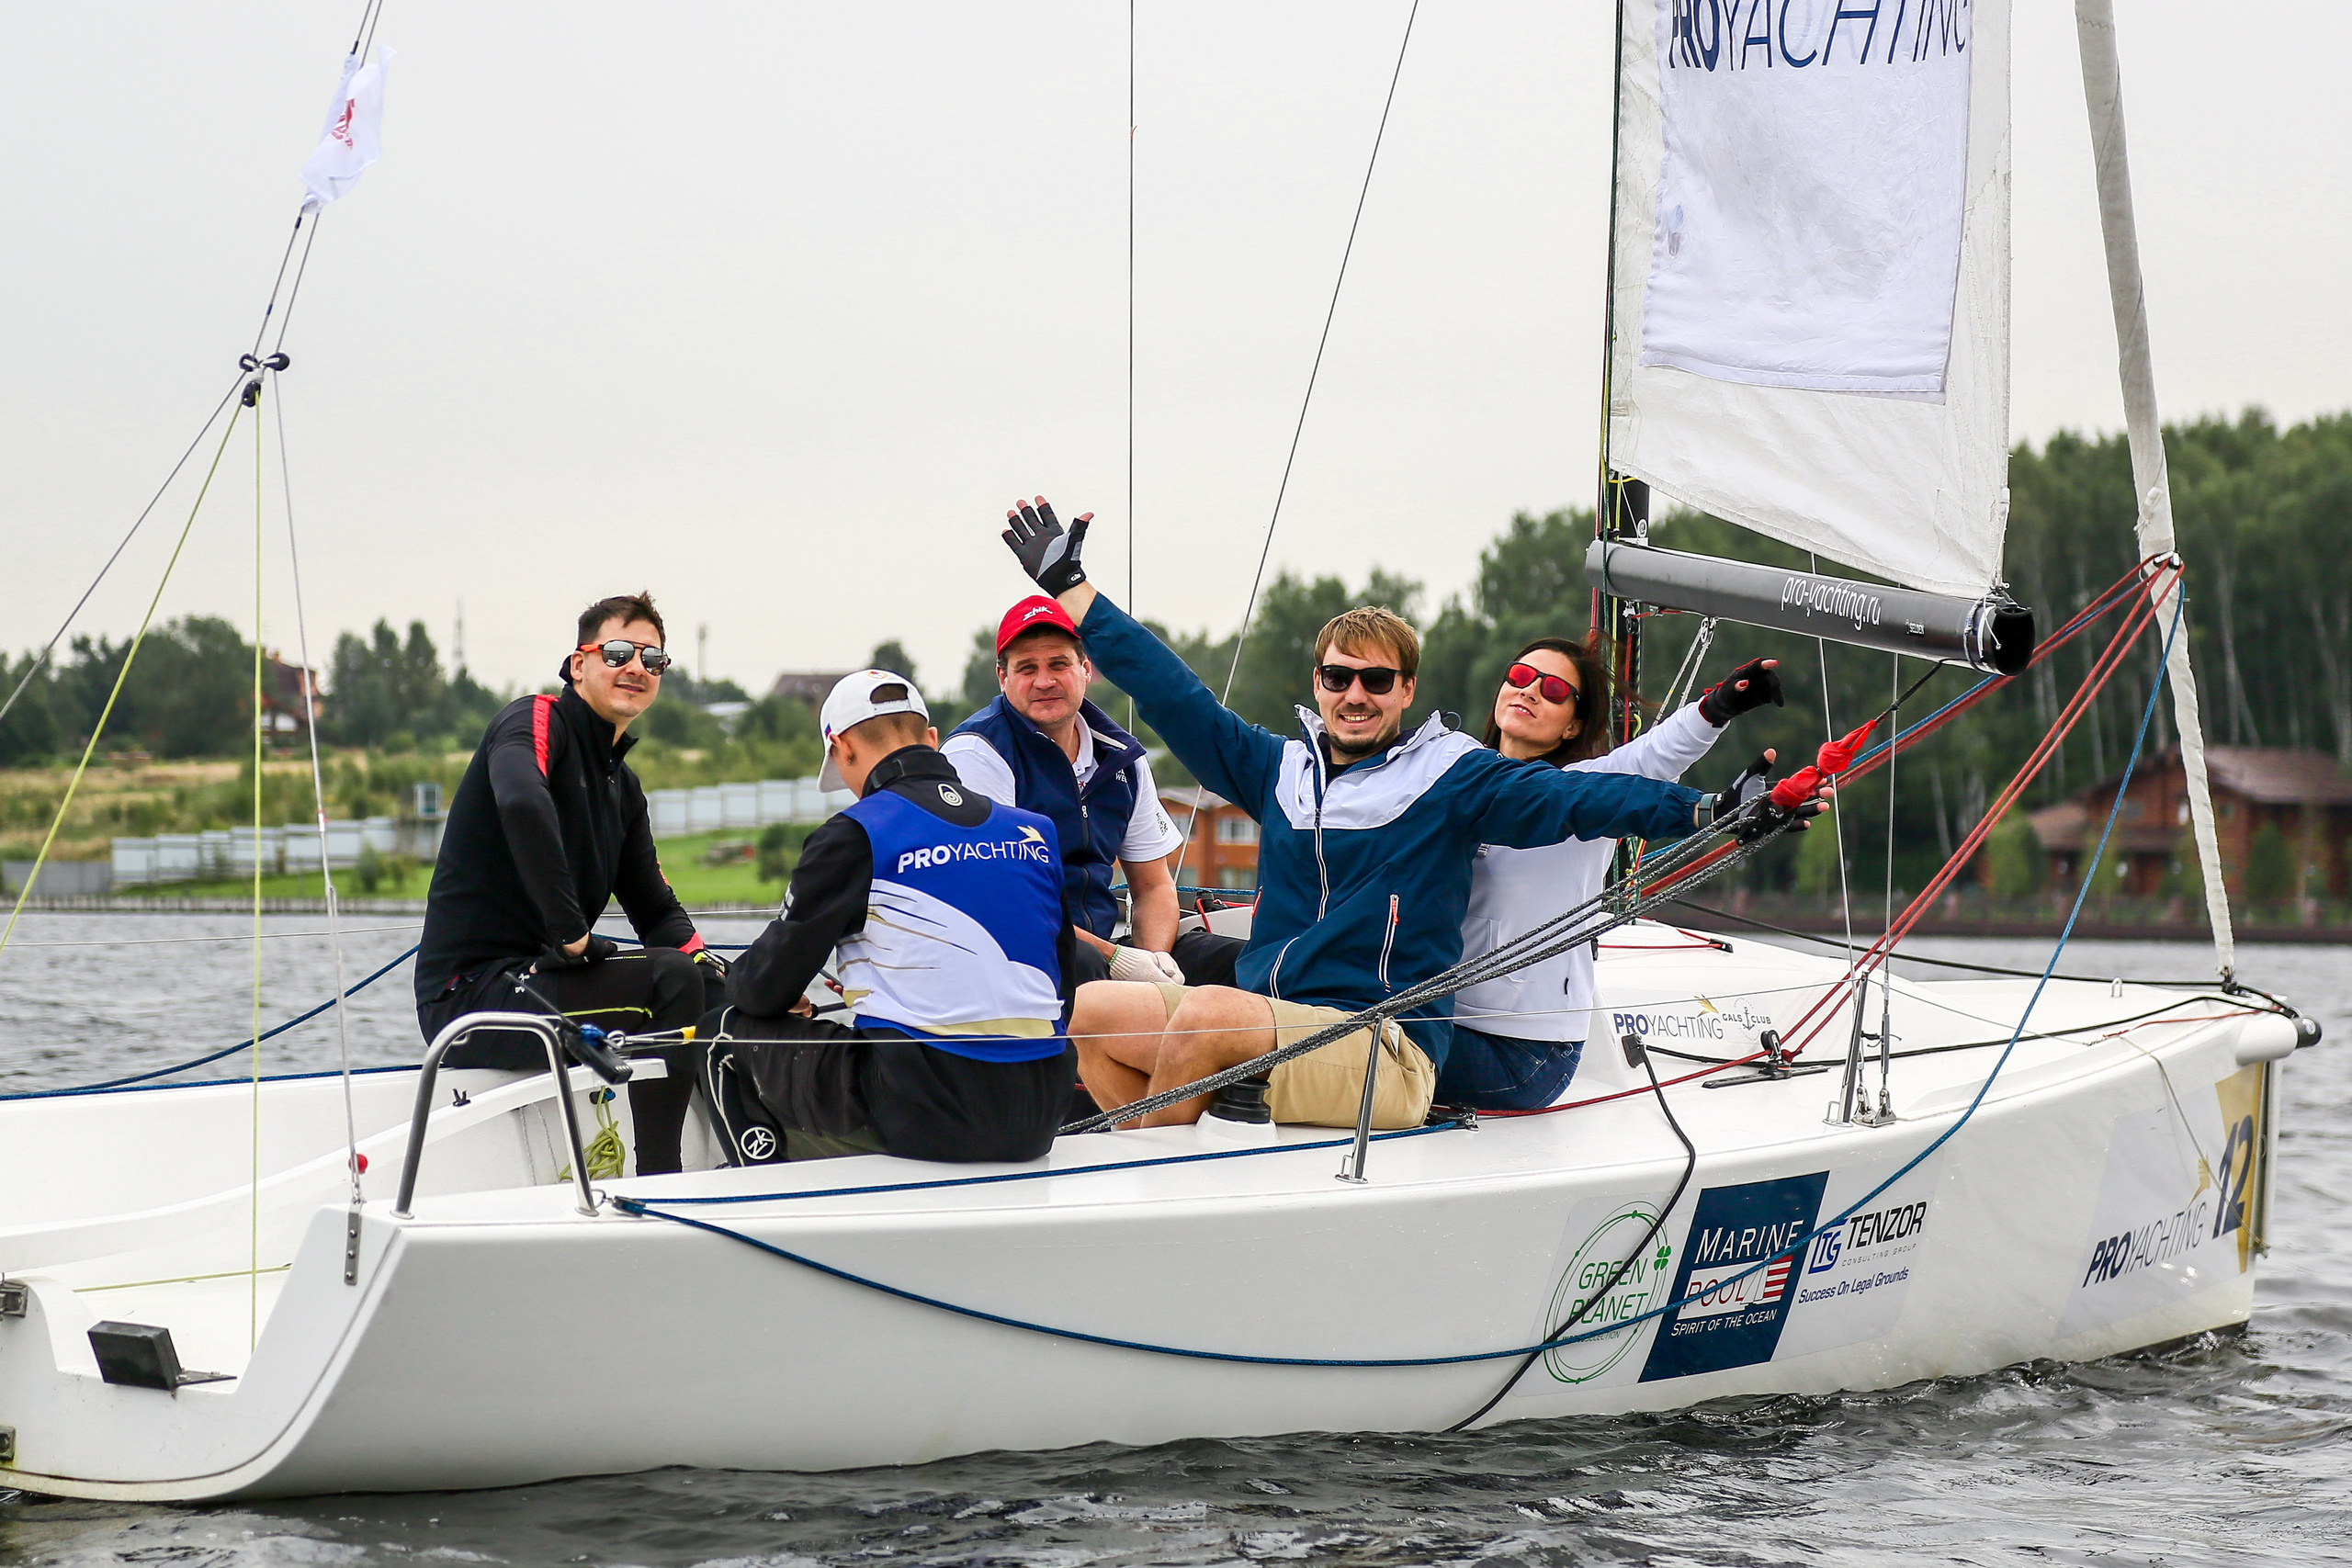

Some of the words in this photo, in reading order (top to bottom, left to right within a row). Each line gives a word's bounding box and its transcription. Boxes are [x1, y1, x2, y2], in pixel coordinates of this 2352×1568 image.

[1781, 576, 1882, 631] pro-yachting.ru
[898, 840, 1049, 874] PROYACHTING
[1612, 1012, 1724, 1040] PROYACHTING
[1722, 1013, 1743, 1022] GALS
[1750, 1015, 1771, 1024] CLUB
[2211, 1114, 2254, 1240] 12
[1694, 1219, 1804, 1264] MARINE
[1846, 1201, 1928, 1250] TENZOR
[1841, 1250, 1890, 1268] CONSULTING
[1893, 1243, 1917, 1255] GROUP
[2082, 1201, 2208, 1289] PROYACHTING
[1682, 1276, 1745, 1310] POOL
[1798, 1286, 1837, 1303] Success
[1837, 1280, 1850, 1296] On
[1850, 1274, 1874, 1294] Legal
[1874, 1266, 1909, 1287] Grounds
[1671, 1320, 1707, 1337] SPIRIT
[1707, 1318, 1722, 1331] OF
[1724, 1314, 1745, 1328] THE
[1746, 1309, 1778, 1325] OCEAN
